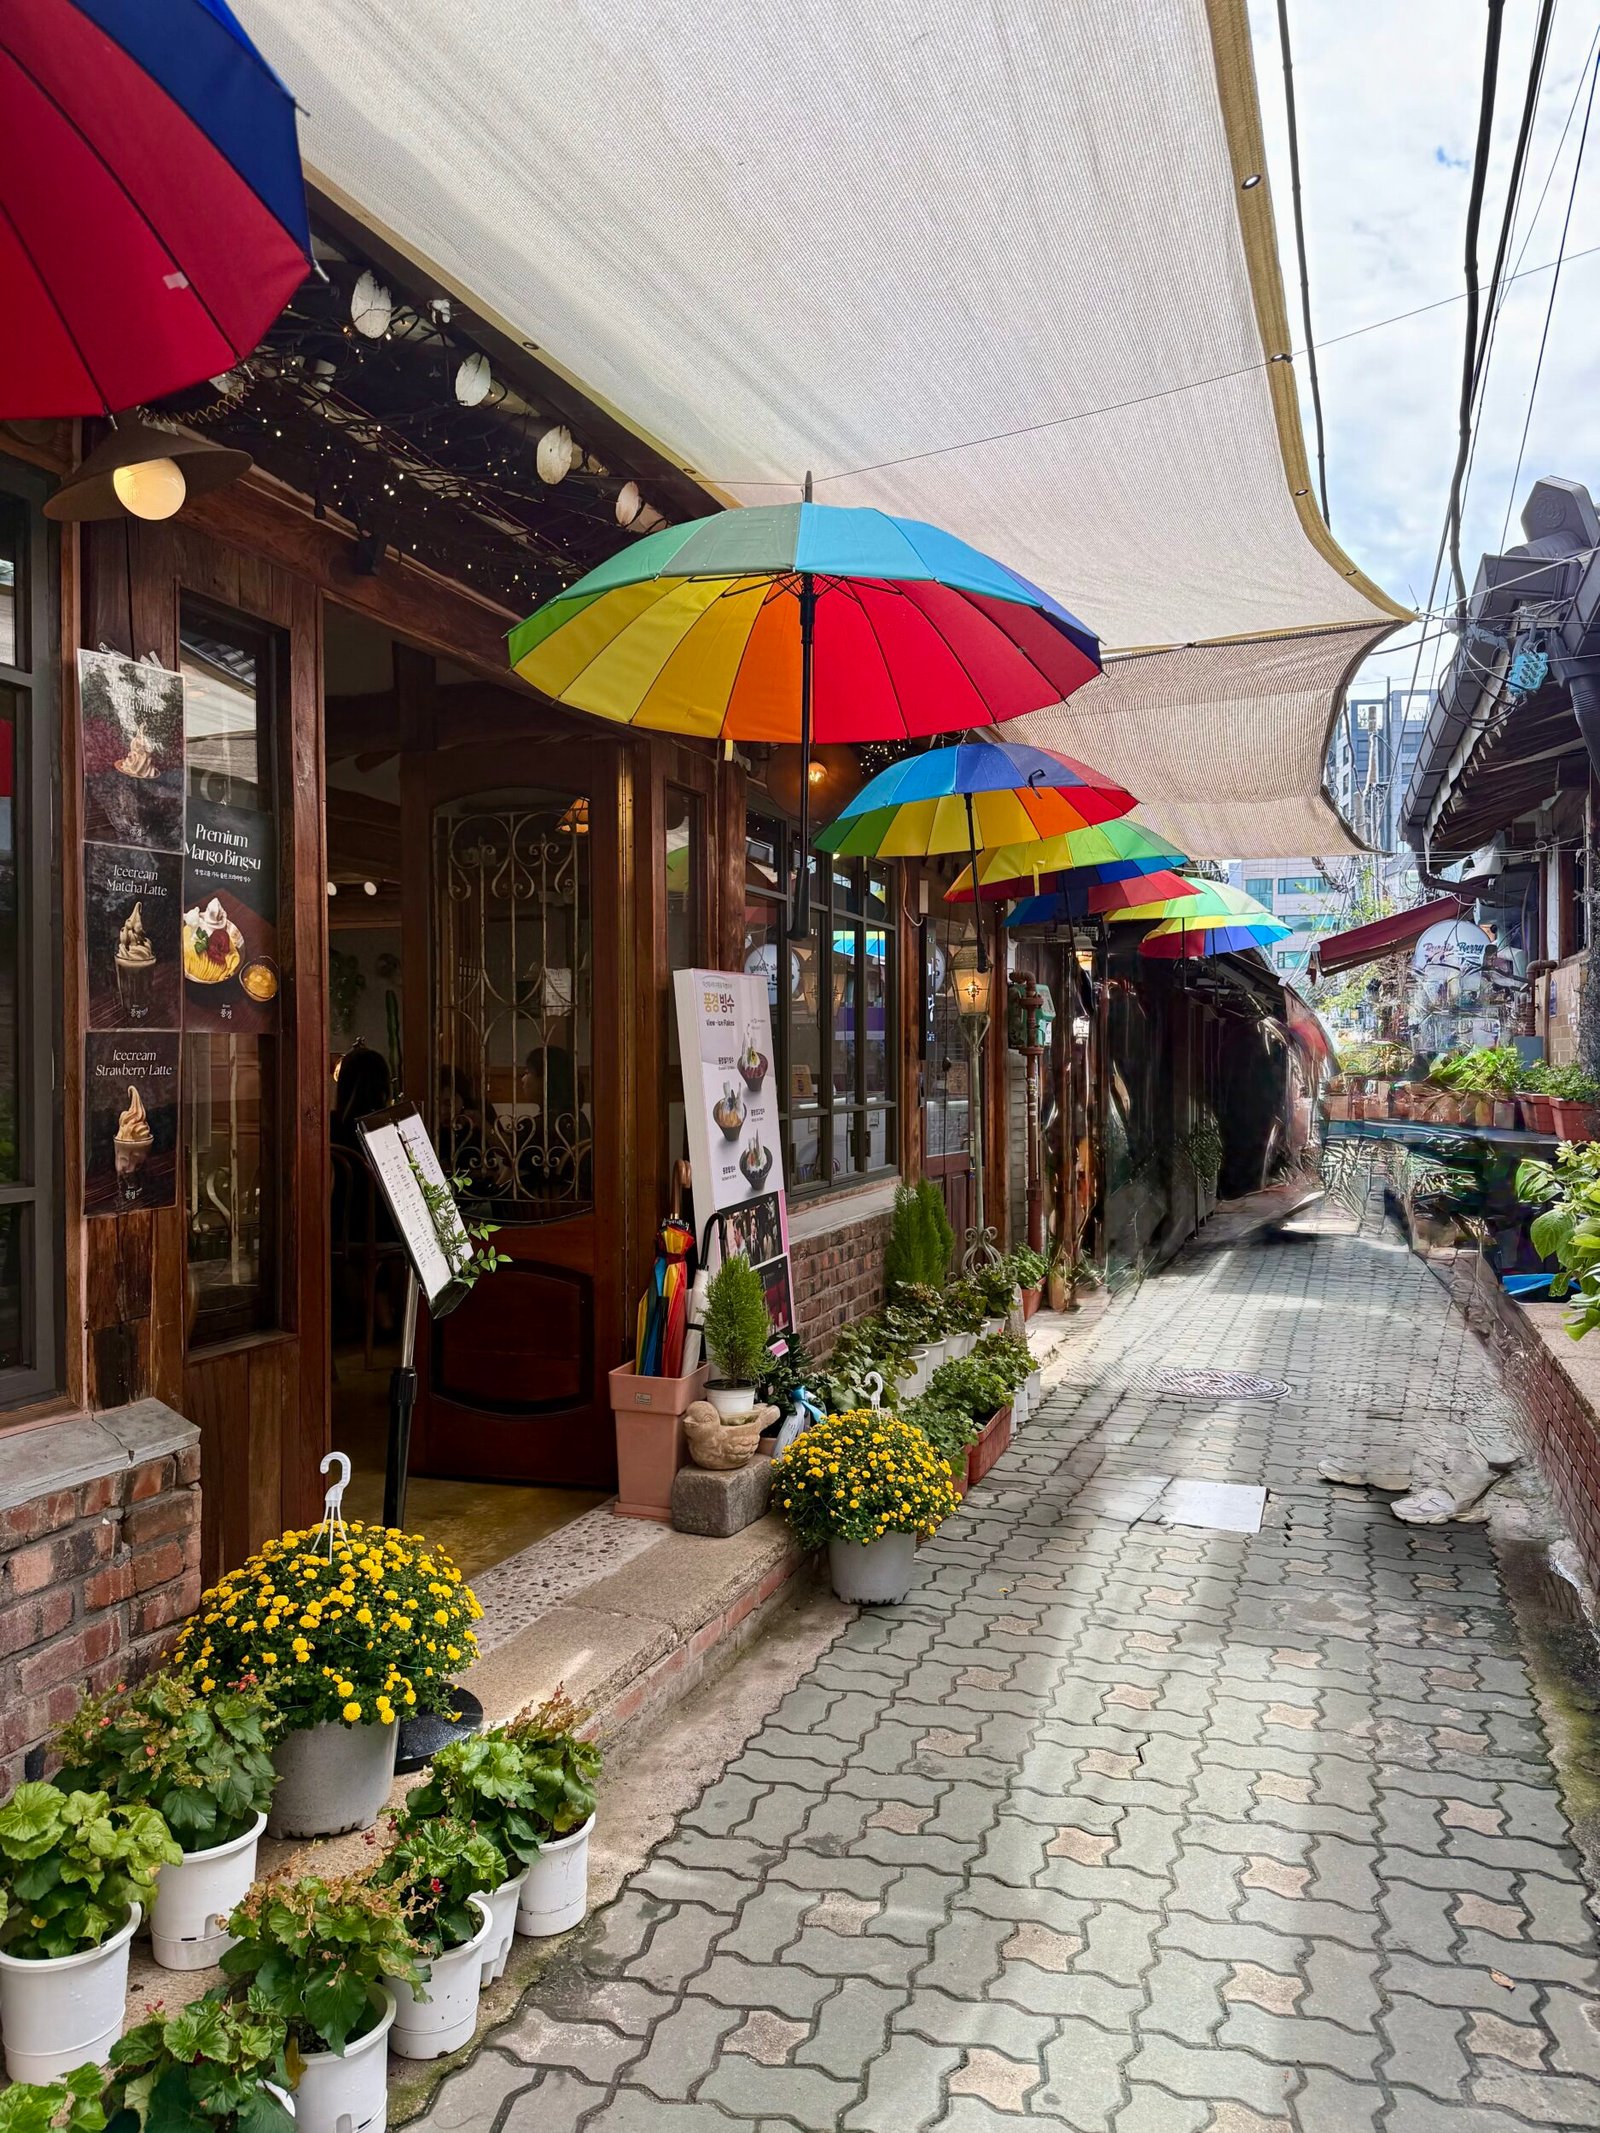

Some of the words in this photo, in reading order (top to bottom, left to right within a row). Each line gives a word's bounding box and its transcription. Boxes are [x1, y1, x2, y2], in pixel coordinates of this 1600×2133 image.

[195, 823, 249, 848] Premium
[184, 841, 223, 866] Mango
[224, 849, 261, 872] Bingsu
[113, 864, 158, 881] Icecream
[106, 878, 142, 894] Matcha
[143, 883, 168, 897] Latte
[112, 1049, 157, 1061] Icecream
[95, 1063, 148, 1078] Strawberry
[149, 1064, 173, 1076] Latte
